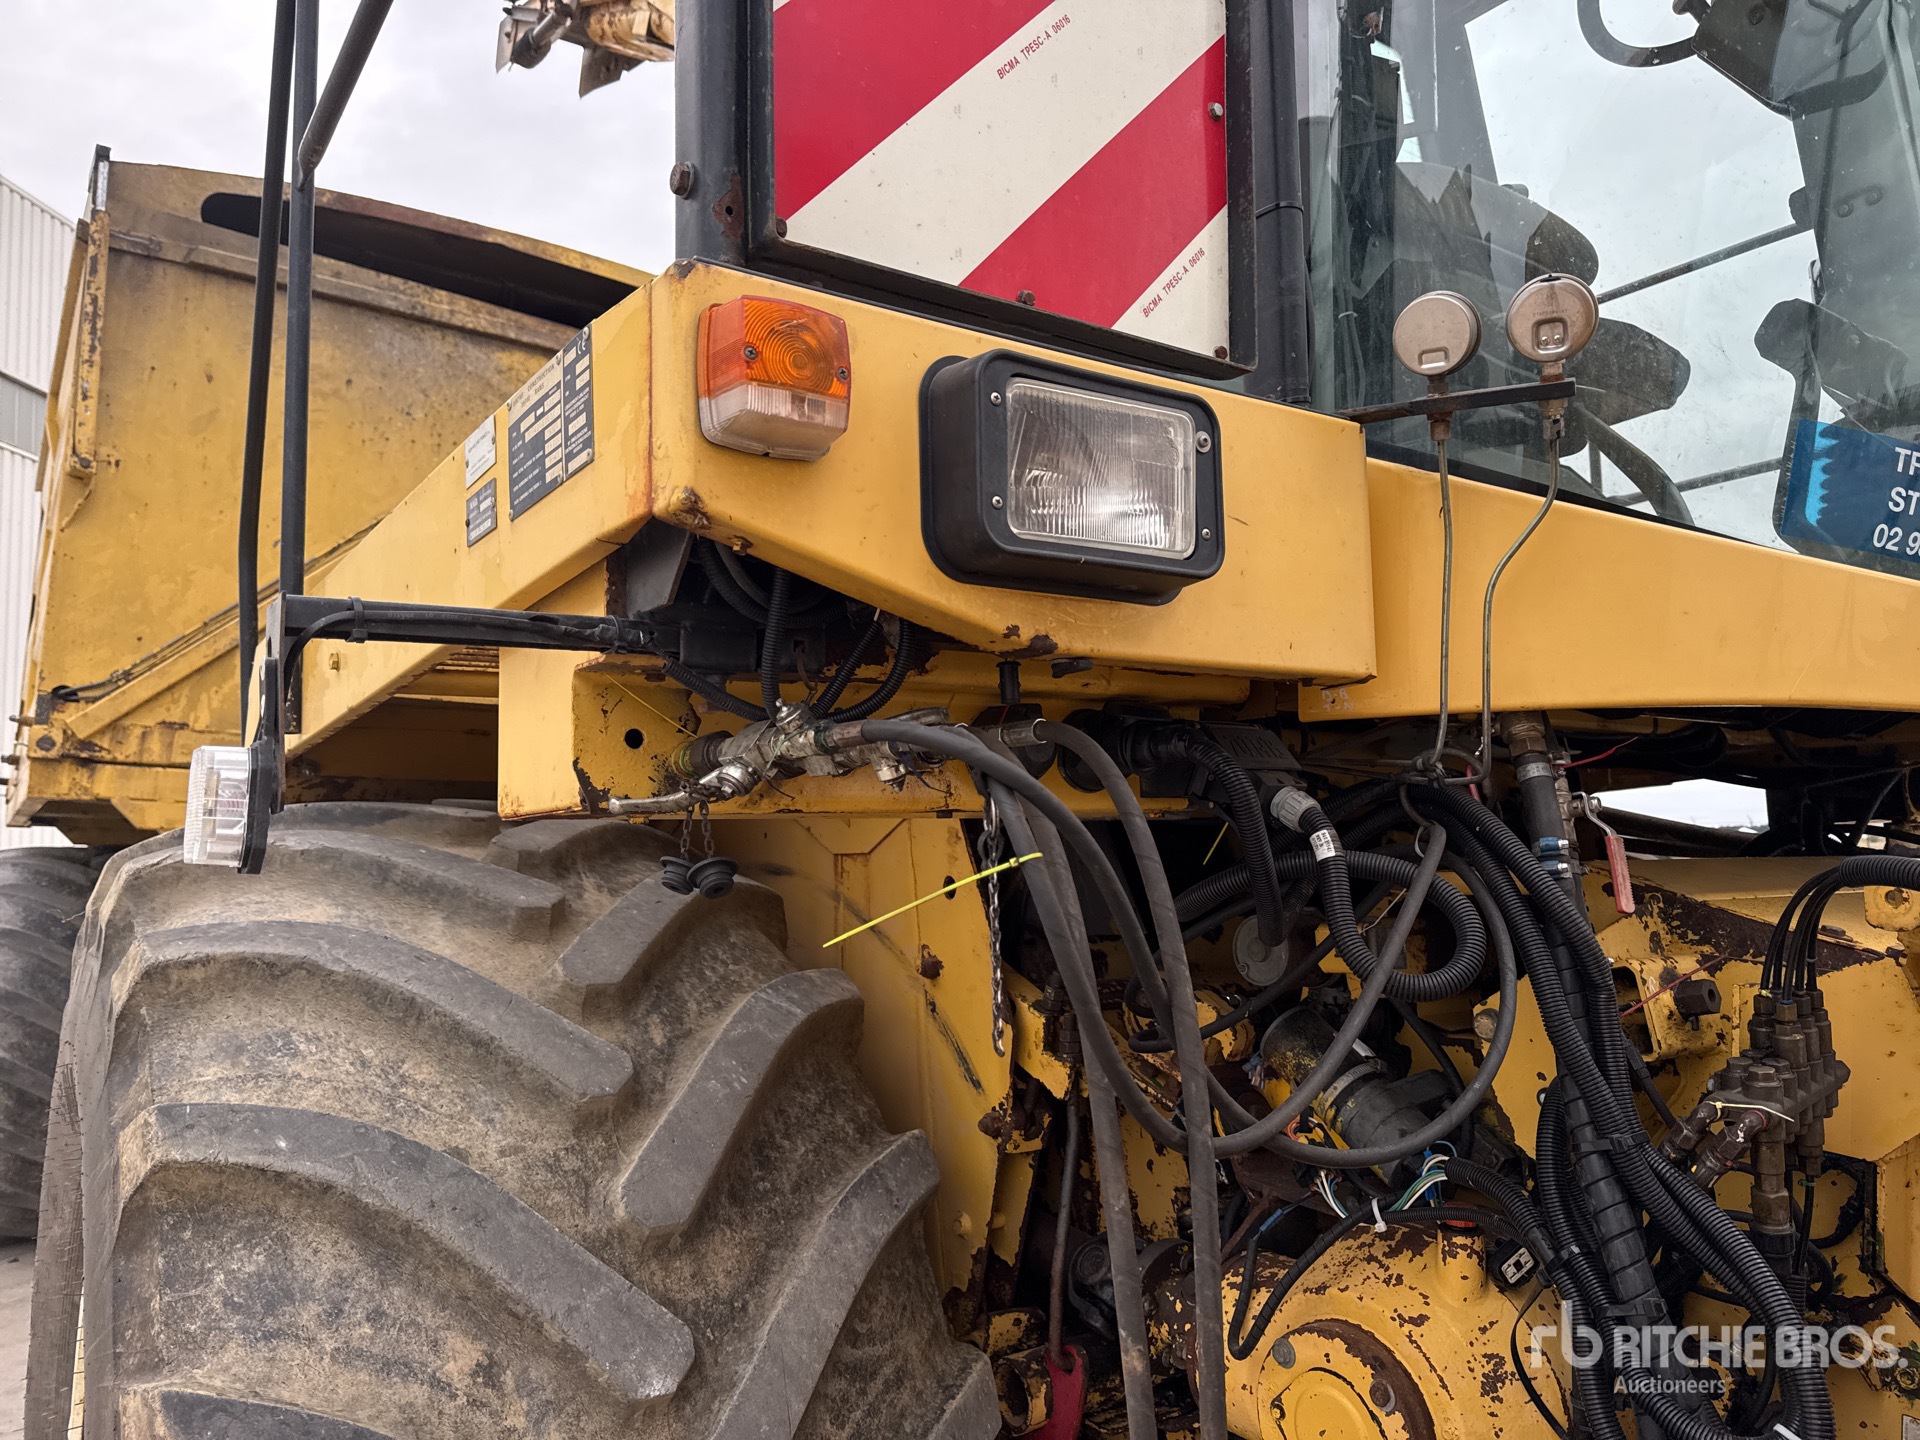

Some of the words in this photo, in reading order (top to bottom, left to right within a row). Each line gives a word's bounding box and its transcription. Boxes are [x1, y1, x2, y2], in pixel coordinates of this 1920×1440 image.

[996, 56, 1021, 80] BICMA
[1020, 30, 1052, 60] TPESC-A
[1051, 14, 1071, 34] 06016
[1142, 294, 1163, 318] BICMA
[1162, 265, 1190, 295] TPESC-A
[1872, 523, 1903, 552] 02
[1905, 531, 1920, 557] 9
